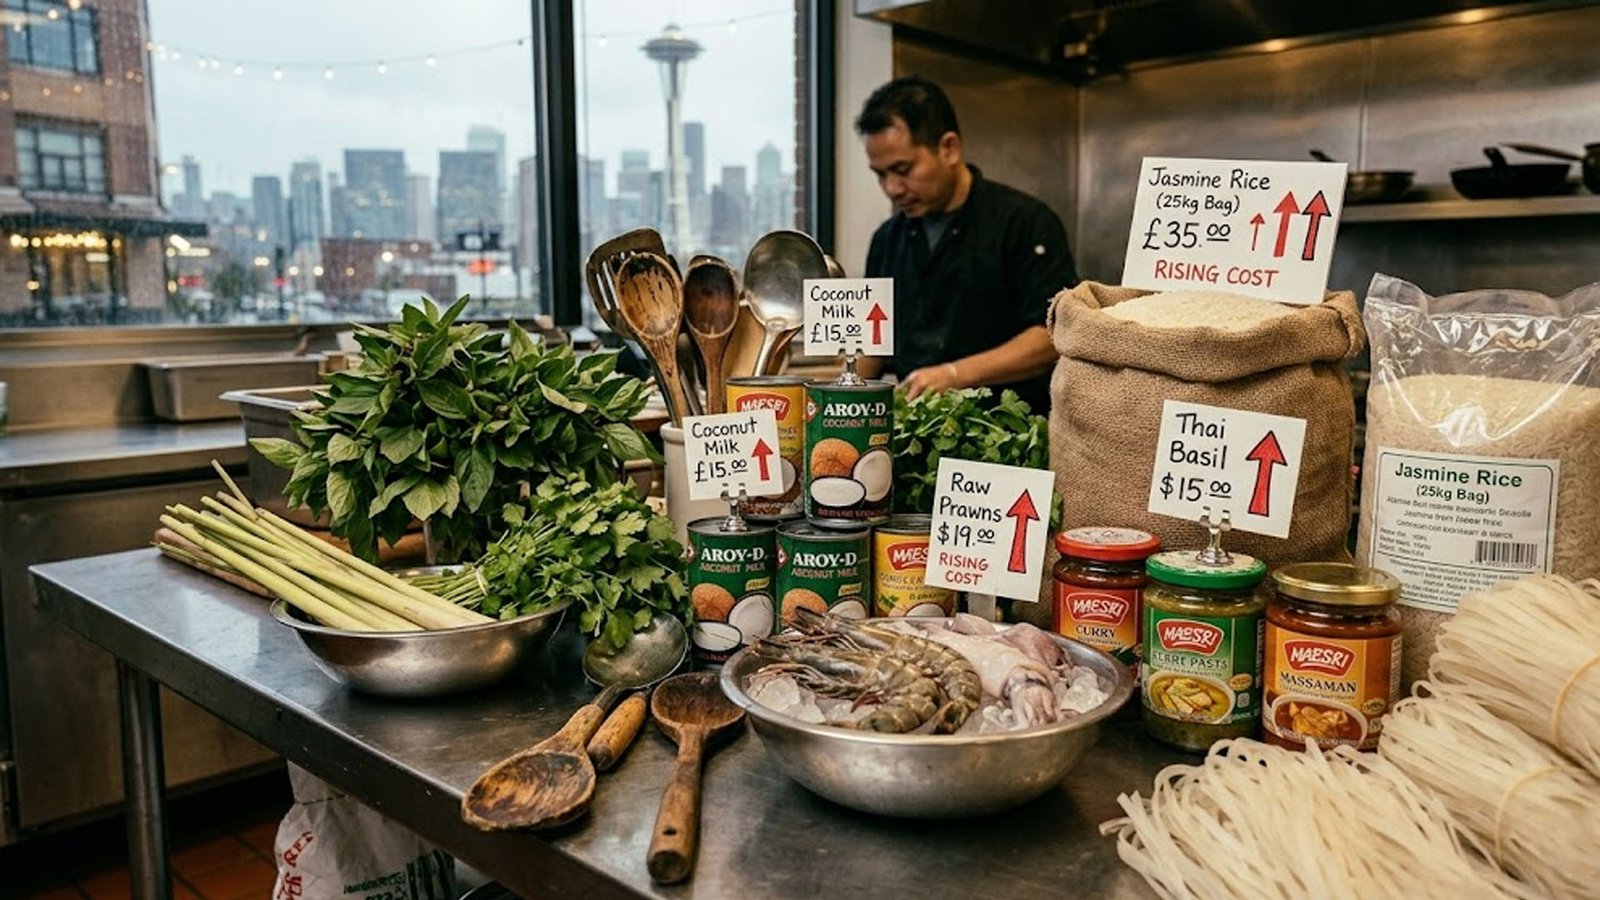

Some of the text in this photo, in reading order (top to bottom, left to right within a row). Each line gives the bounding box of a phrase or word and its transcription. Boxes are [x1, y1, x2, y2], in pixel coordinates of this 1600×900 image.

[1149, 166, 1271, 190] Jasmine Rice
[1156, 192, 1241, 217] (25kg Bag)
[1154, 259, 1279, 288] RISING COST
[810, 284, 872, 301] Coconut
[822, 304, 855, 319] Milk
[692, 417, 757, 438] Coconut
[1175, 412, 1226, 439] Thai
[704, 439, 740, 456] Milk
[1169, 440, 1227, 470] Basil
[951, 472, 991, 495] Raw
[1395, 462, 1523, 488] Jasmine Rice
[1416, 484, 1490, 505] (25kg Bag)
[940, 496, 1002, 523] Prawns
[893, 547, 929, 563] MAES
[939, 552, 989, 571] RISING
[945, 570, 983, 586] COST
[1075, 625, 1117, 638] CURRY
[1280, 671, 1357, 693] MASSAMAN
